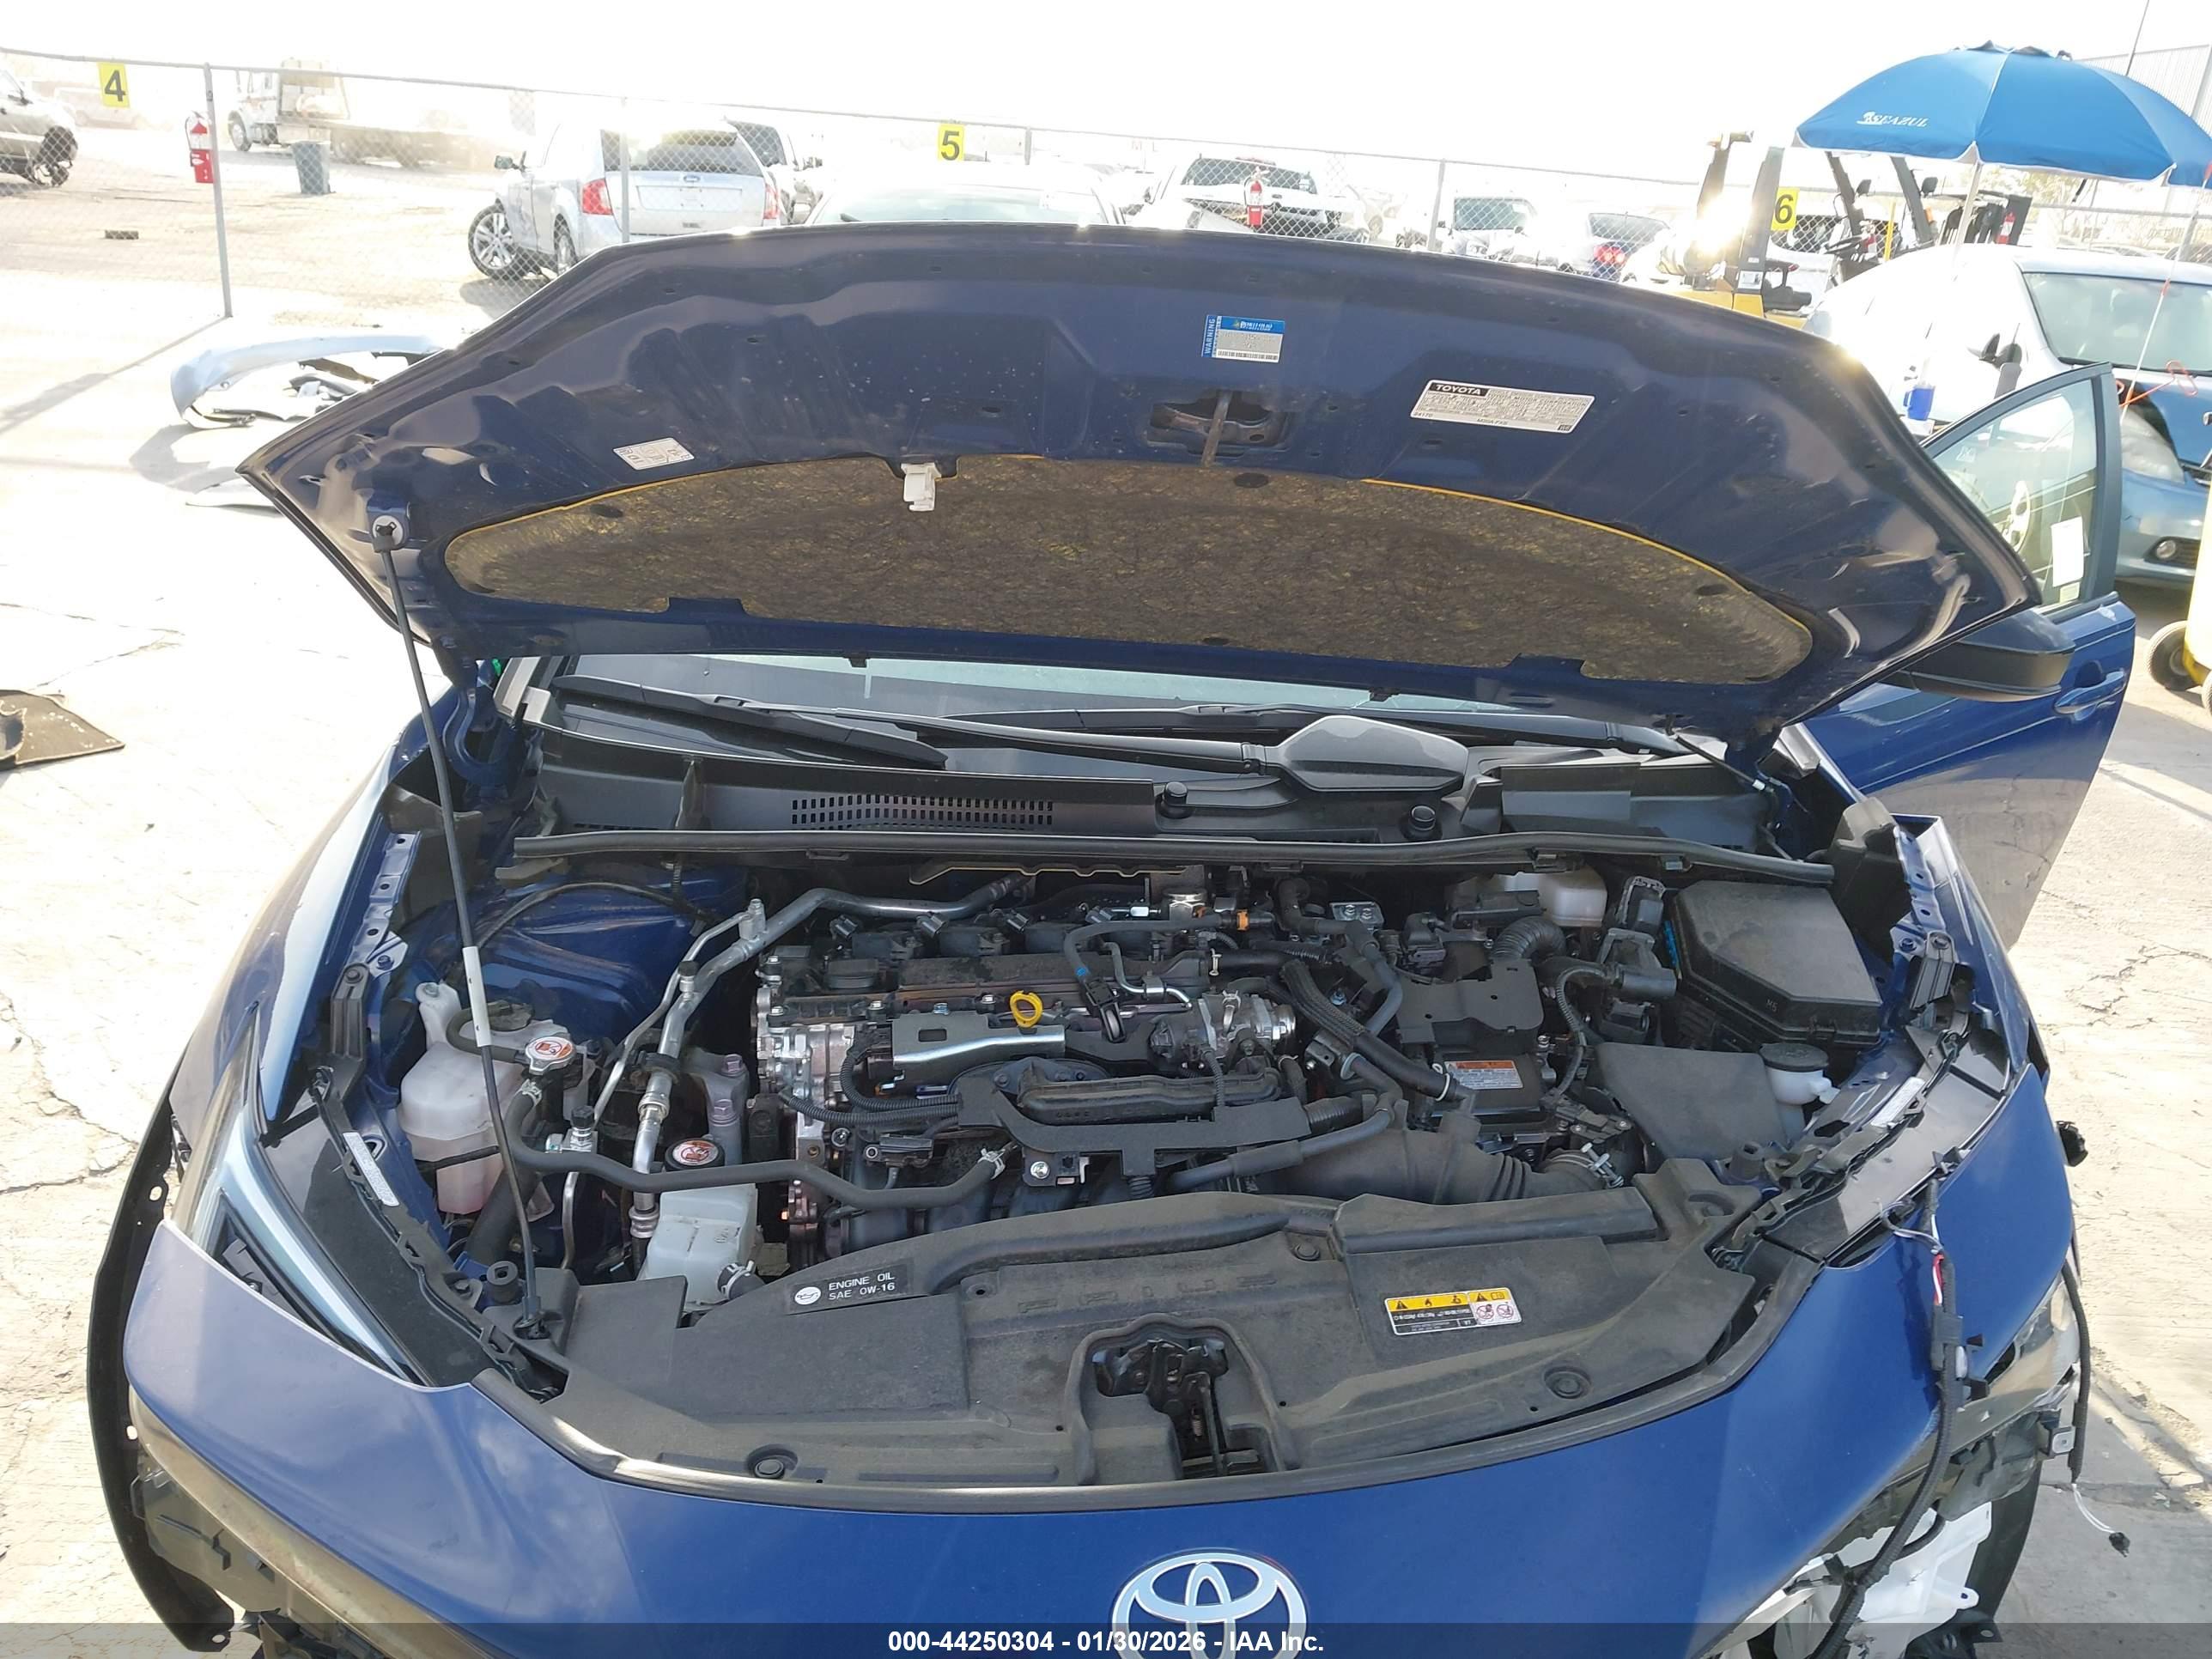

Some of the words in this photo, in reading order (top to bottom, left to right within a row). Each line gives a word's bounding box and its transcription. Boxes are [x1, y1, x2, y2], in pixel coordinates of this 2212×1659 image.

[105, 70, 126, 101] 4
[941, 131, 959, 161] 5
[1775, 194, 1793, 223] 6
[1204, 318, 1216, 354] WARNING
[1436, 385, 1480, 395] TOYOTA
[829, 1276, 870, 1291] ENGINE
[877, 1273, 895, 1282] OIL
[829, 1290, 853, 1300] SAE
[860, 1282, 895, 1295] 0W-16
